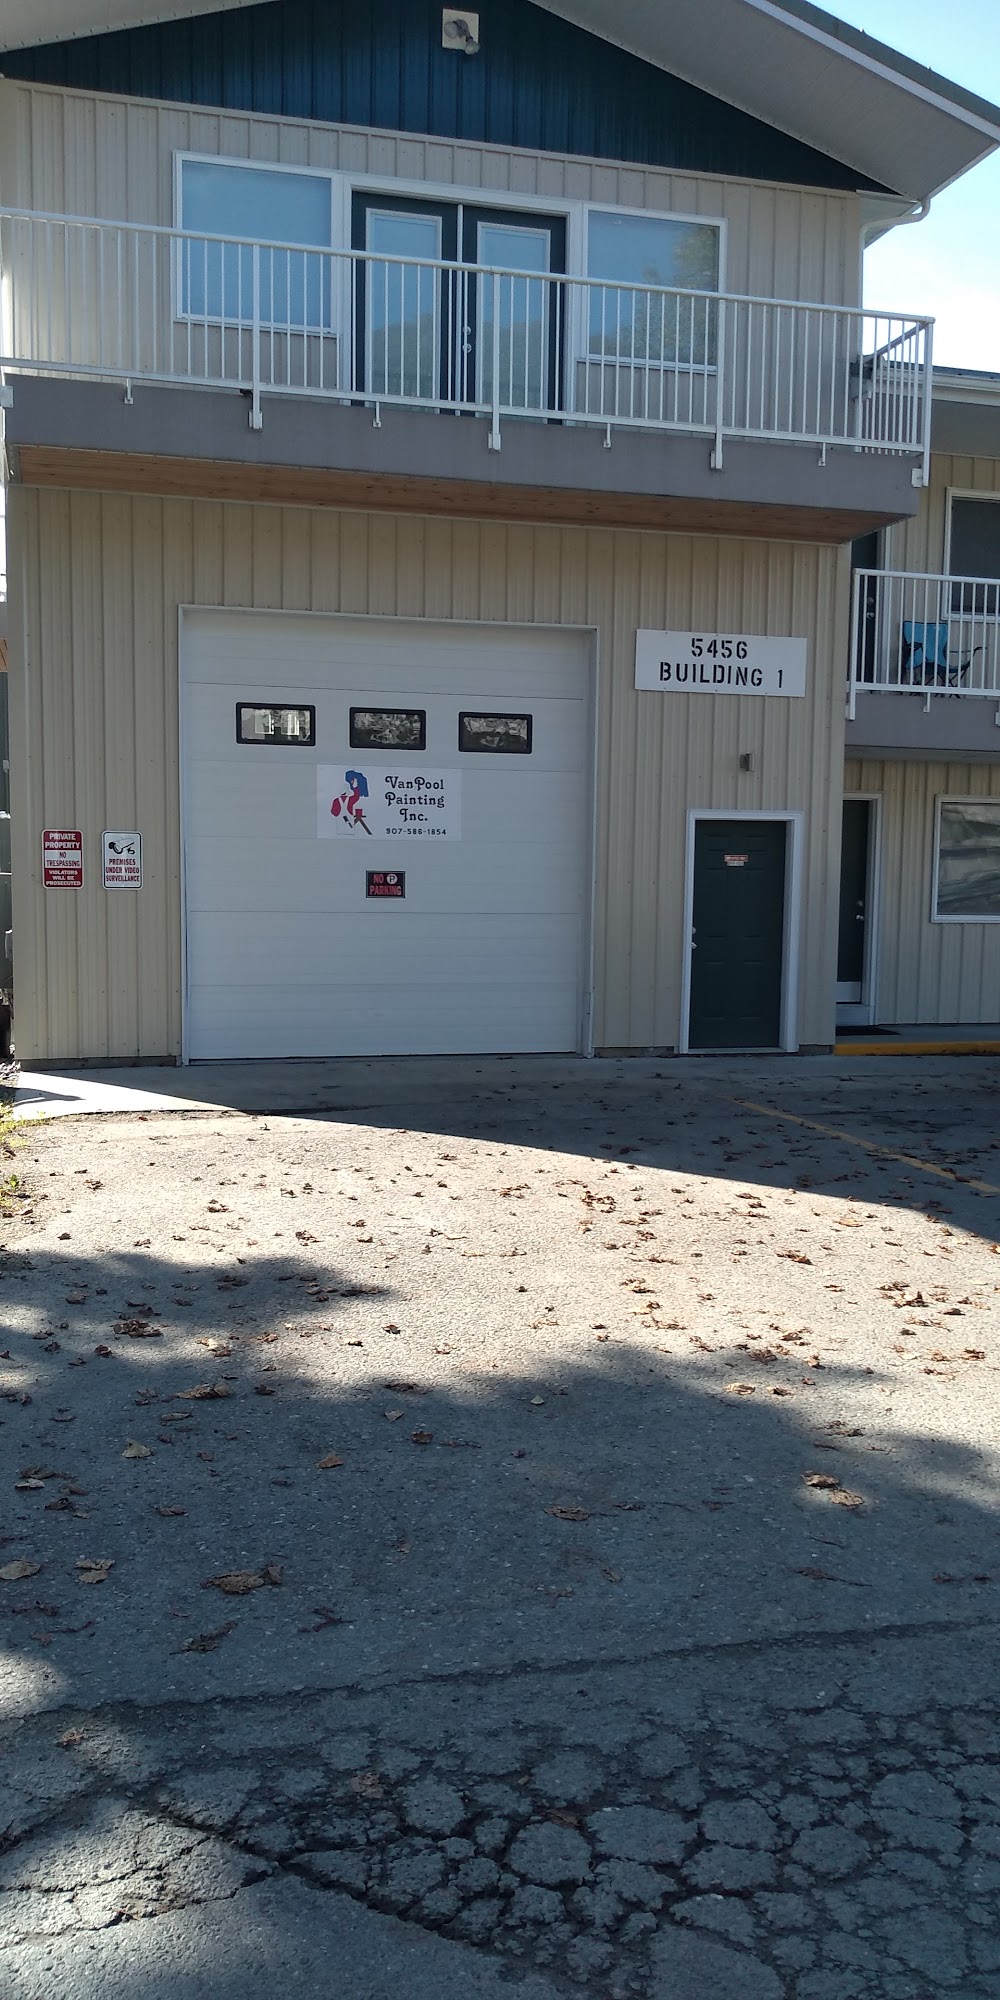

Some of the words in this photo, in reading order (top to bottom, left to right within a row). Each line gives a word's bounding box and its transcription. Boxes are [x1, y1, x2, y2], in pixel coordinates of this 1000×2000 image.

[691, 637, 748, 660] 5456
[659, 661, 763, 687] BUILDING
[777, 669, 783, 689] 1
[384, 775, 445, 791] VanPool
[384, 791, 445, 808] Painting
[399, 808, 428, 822] Inc.
[385, 827, 447, 836] 907-586-1854
[373, 873, 384, 884] NO
[369, 885, 402, 895] PARKING
